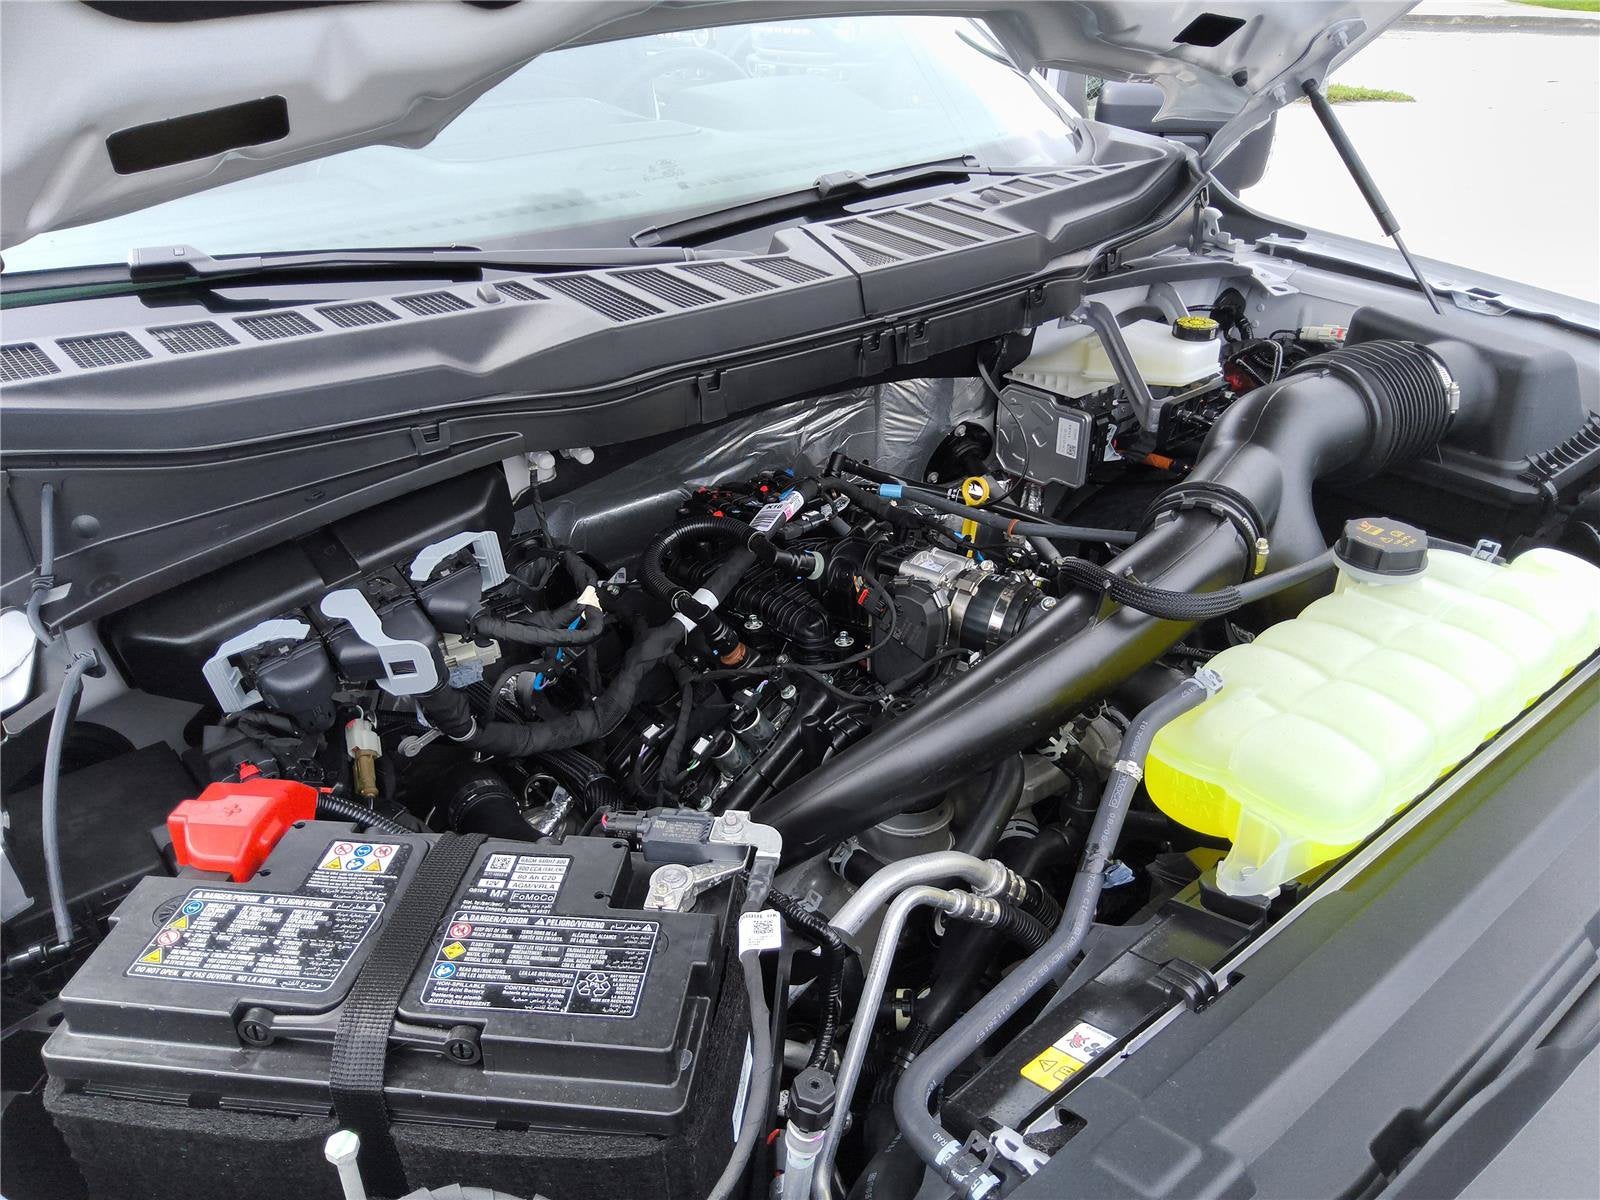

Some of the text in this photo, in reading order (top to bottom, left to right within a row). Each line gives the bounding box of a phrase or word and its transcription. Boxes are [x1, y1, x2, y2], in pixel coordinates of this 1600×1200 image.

[490, 890, 510, 898] MF
[511, 893, 554, 902] FoMoCo
[468, 914, 529, 924] DANGER/POISON
[544, 918, 605, 928] PELIGRO/VENENO
[932, 1132, 948, 1148] RAD
